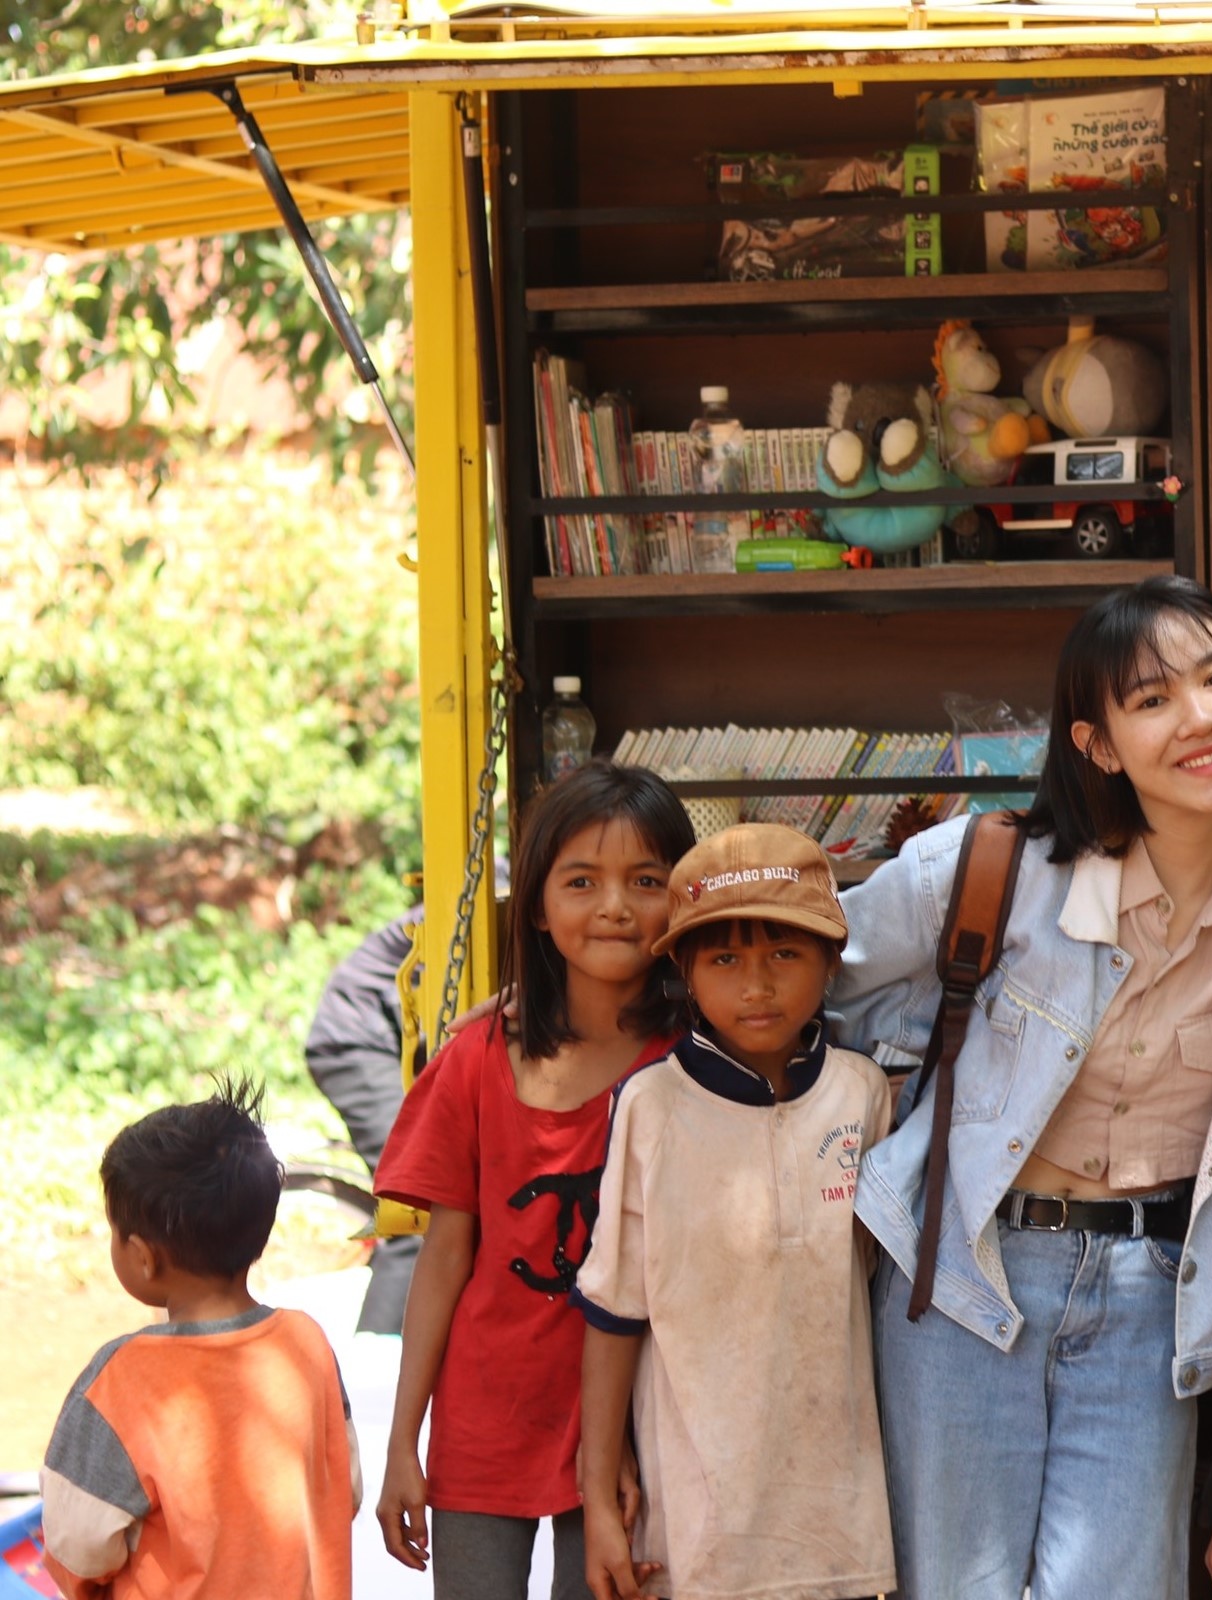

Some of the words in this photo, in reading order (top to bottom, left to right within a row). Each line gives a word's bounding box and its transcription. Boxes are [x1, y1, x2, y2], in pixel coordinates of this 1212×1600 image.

[707, 868, 759, 891] CHICAGO
[763, 866, 800, 883] BULLS
[821, 1187, 845, 1203] TAM
